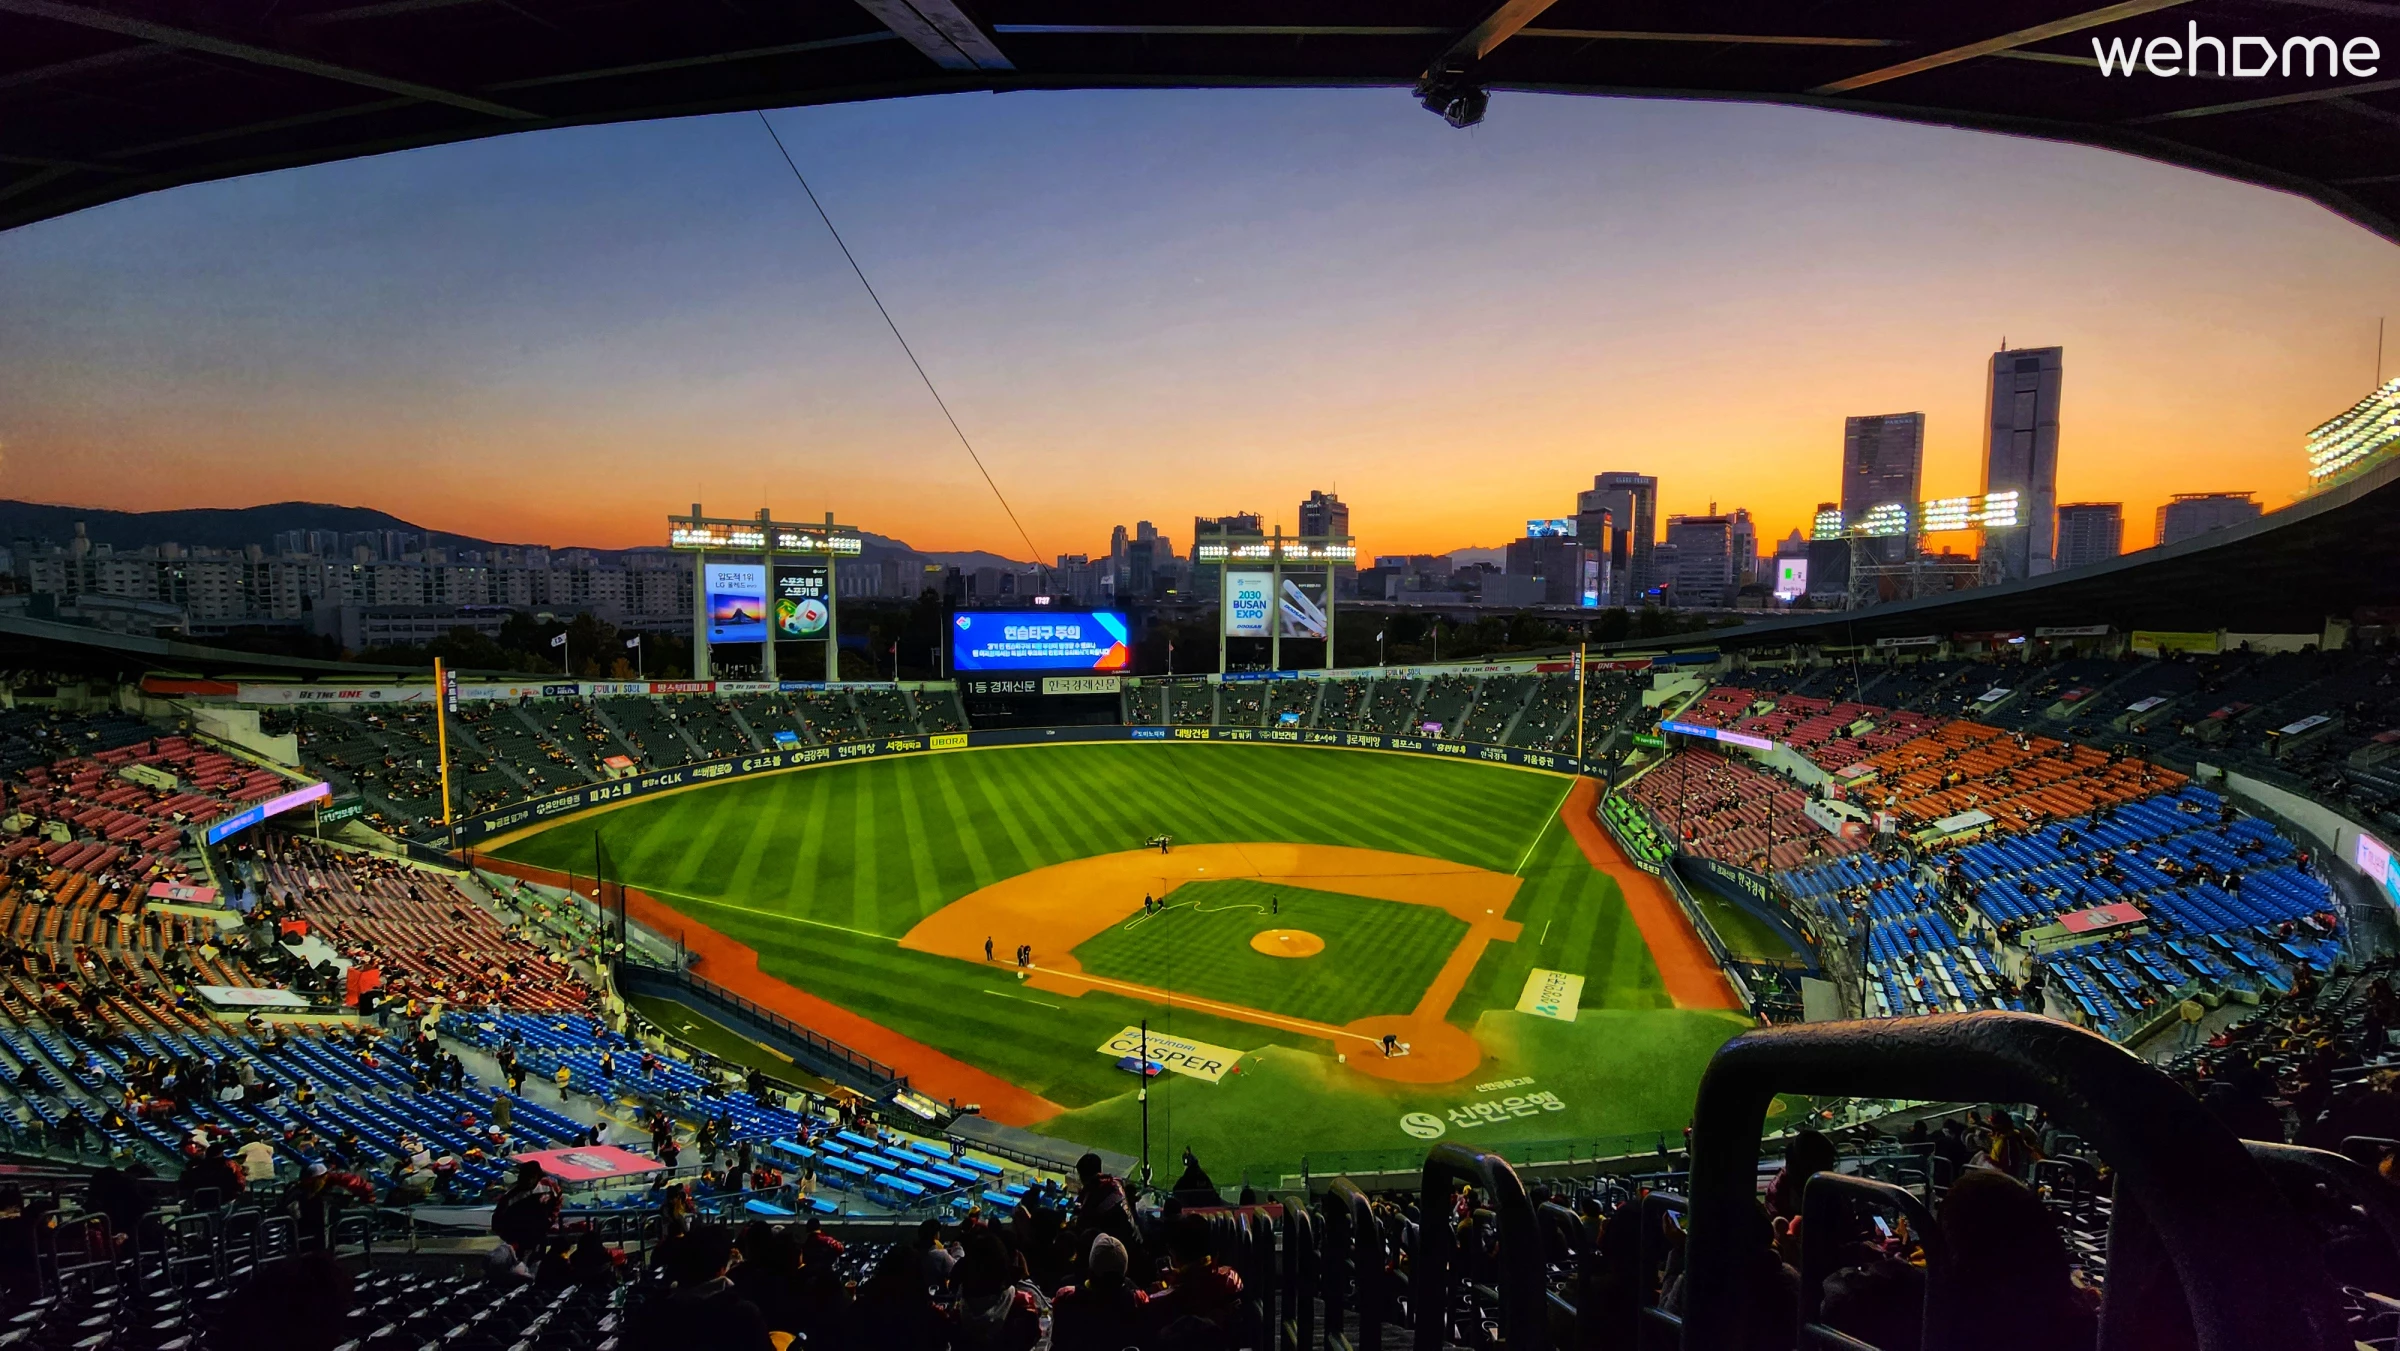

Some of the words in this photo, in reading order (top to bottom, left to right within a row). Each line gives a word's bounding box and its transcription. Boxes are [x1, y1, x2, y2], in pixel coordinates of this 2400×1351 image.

[718, 573, 741, 581] 압도적
[742, 573, 754, 581] 1위
[1238, 591, 1261, 600] 2030
[1233, 600, 1267, 609] BUSAN
[1236, 610, 1263, 619] EXPO
[1004, 626, 1053, 640] 연습타구
[1055, 626, 1081, 640] 주의
[968, 682, 987, 693] 1등
[990, 681, 1036, 693] 경제신문
[1048, 678, 1115, 692] 한국경제신문
[299, 691, 313, 699] BE
[315, 691, 336, 699] THE
[338, 690, 364, 699] ONE
[1175, 729, 1210, 739] 대방건설
[1271, 731, 1298, 740] 대보건설
[886, 741, 922, 750] 서경대학교
[931, 737, 966, 746] UBORA
[803, 748, 830, 762] 금강주택
[838, 744, 875, 758] 현대해상
[1480, 751, 1508, 762] 한국경제
[1523, 754, 1554, 767] 키움증권
[660, 773, 682, 785] CLK
[589, 783, 632, 802] 피자스쿨
[545, 795, 581, 809] 유안타증권
[1738, 872, 1766, 902] 한국경제
[1110, 1039, 1223, 1075] CASPER
[812, 1102, 825, 1113] 114
[1447, 1091, 1566, 1129] 신한은행
[951, 1143, 965, 1155] 113
